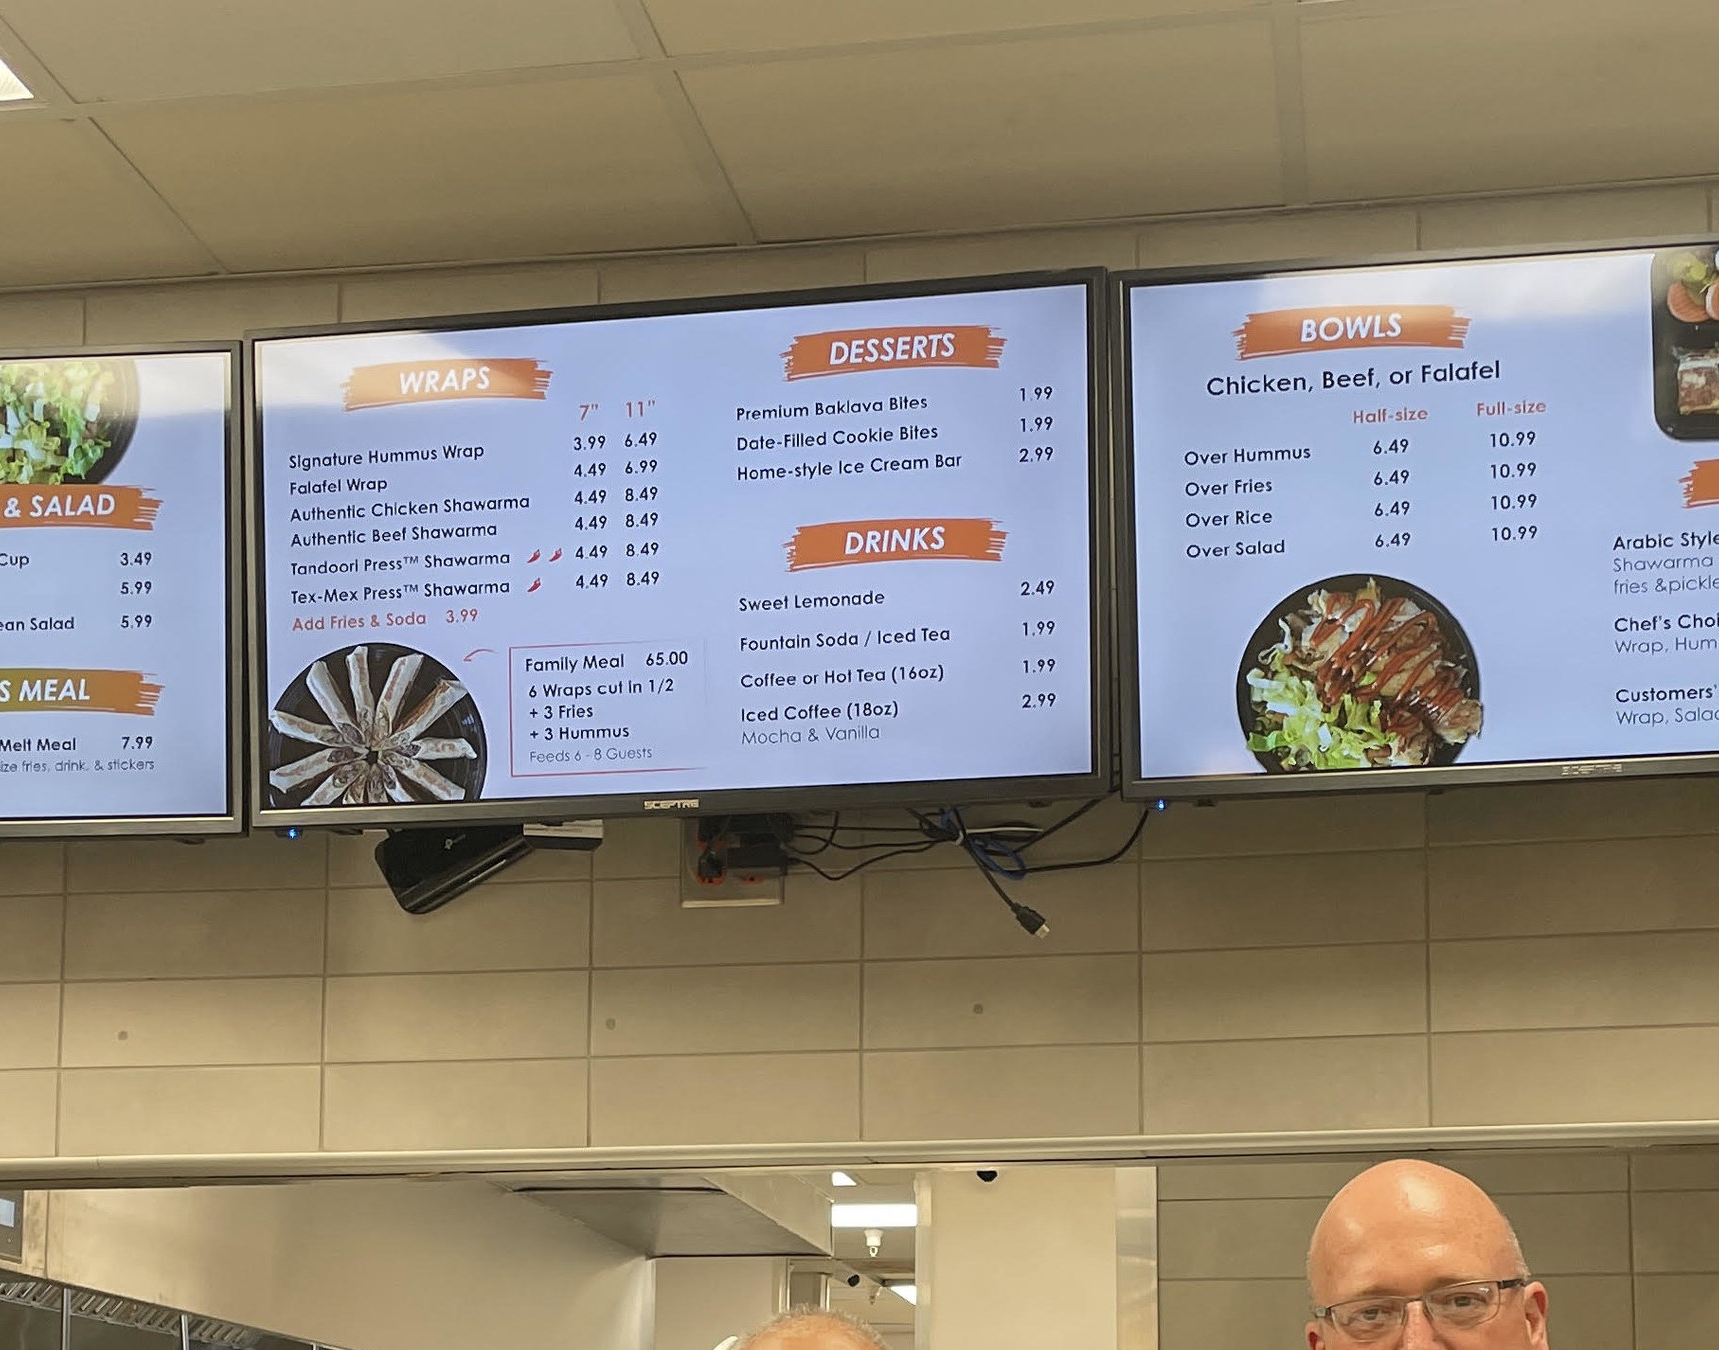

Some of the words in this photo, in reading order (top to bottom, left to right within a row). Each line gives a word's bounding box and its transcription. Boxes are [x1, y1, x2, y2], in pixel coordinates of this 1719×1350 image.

[1300, 313, 1403, 344] BOWLS
[829, 333, 956, 365] DESSERTS
[399, 364, 493, 395] WRAPS
[1206, 373, 1314, 396] Chicken,
[1322, 367, 1380, 389] Beef,
[1421, 359, 1500, 383] Falafel
[1019, 385, 1053, 402] 1.99
[736, 404, 809, 421] Premium
[815, 399, 883, 416] Baklava
[889, 395, 928, 411] Bites
[1353, 407, 1428, 425] Half-size
[1476, 399, 1546, 417] Full-size
[1020, 416, 1054, 433] 1.99
[573, 435, 606, 451] 3.99
[624, 431, 658, 448] 6.49
[737, 431, 827, 451] Date-Filled
[832, 427, 894, 445] Cookie
[900, 424, 938, 441] Bites
[1372, 438, 1409, 455] 6.49
[1490, 430, 1536, 448] 10.99
[288, 452, 363, 472] Signature
[368, 449, 438, 464] Hummus
[442, 444, 484, 461] Wrap
[1018, 446, 1054, 463] 2.99
[1184, 451, 1228, 466] Over
[1234, 447, 1311, 463] Hummus
[573, 462, 607, 478] 4.49
[624, 459, 658, 475] 6.99
[737, 461, 833, 481] Home-style
[838, 459, 865, 475] Ice
[870, 457, 929, 473] Cream
[935, 453, 962, 469] Bar
[289, 478, 342, 496] Falafel
[346, 477, 388, 493] Wrap
[624, 485, 658, 502] 8.49
[1184, 481, 1229, 497] Over
[1234, 478, 1273, 495] Fries
[3, 497, 22, 518] &
[29, 493, 115, 517] SALAD
[574, 489, 607, 505] 4.49
[290, 504, 366, 523] Authentic
[371, 500, 438, 517] Chicken
[443, 497, 530, 513] Shawarma
[1185, 512, 1230, 528] Over
[1235, 509, 1273, 525] Rice
[290, 529, 366, 548] Authentic
[372, 526, 407, 543] Beef
[411, 525, 497, 541] Shawarma
[844, 526, 945, 555] DRINKS
[1374, 531, 1411, 548] 6.49
[1612, 533, 1674, 551] Arabic
[1186, 544, 1230, 559] Over
[1235, 539, 1285, 556] Salad
[120, 551, 152, 567] 3.49
[290, 558, 359, 576] Tandoori
[424, 553, 510, 569] Shawarma
[1612, 556, 1714, 573] Shawarma
[120, 580, 152, 595] 5.99
[290, 588, 359, 605] Tex-Mex
[424, 582, 510, 598] Shawarma
[1020, 579, 1055, 597] 2.49
[1614, 578, 1648, 595] fries
[738, 595, 789, 612] Sweet
[794, 590, 885, 609] Lemonade
[29, 616, 75, 631] Salad
[120, 614, 152, 629] 5.99
[292, 616, 326, 632] Add
[330, 615, 365, 630] Fries
[386, 611, 426, 627] Soda
[445, 608, 478, 624] 3.99
[1022, 620, 1056, 637] 1.99
[740, 633, 811, 652] Fountain
[816, 631, 859, 648] Soda
[877, 627, 916, 645] Iced
[920, 627, 950, 642] Tea
[1614, 639, 1669, 656] Wrap,
[525, 655, 579, 674] Family
[582, 653, 624, 670] Meal
[646, 650, 688, 667] 65.00
[740, 672, 797, 689] Coffee
[824, 669, 852, 685] Hot
[856, 668, 886, 683] Tea
[891, 664, 944, 685] (16oz)
[18, 678, 90, 702] MEAL
[542, 683, 592, 700] Wraps
[596, 680, 623, 695] cut
[648, 677, 674, 695] 1/2
[1022, 692, 1056, 709] 2.99
[558, 703, 594, 719] Fries
[741, 706, 778, 723] Iced
[784, 703, 842, 721] Coffee
[846, 700, 898, 721] (18oz)
[1615, 710, 1669, 727] Wrap,
[121, 735, 153, 750] 7.99
[559, 726, 630, 741] Hummus
[741, 728, 802, 745] Mocha
[825, 725, 880, 741] Vanilla
[36, 737, 76, 752] Meal
[529, 749, 572, 763] Feeds
[605, 747, 653, 761] Guests
